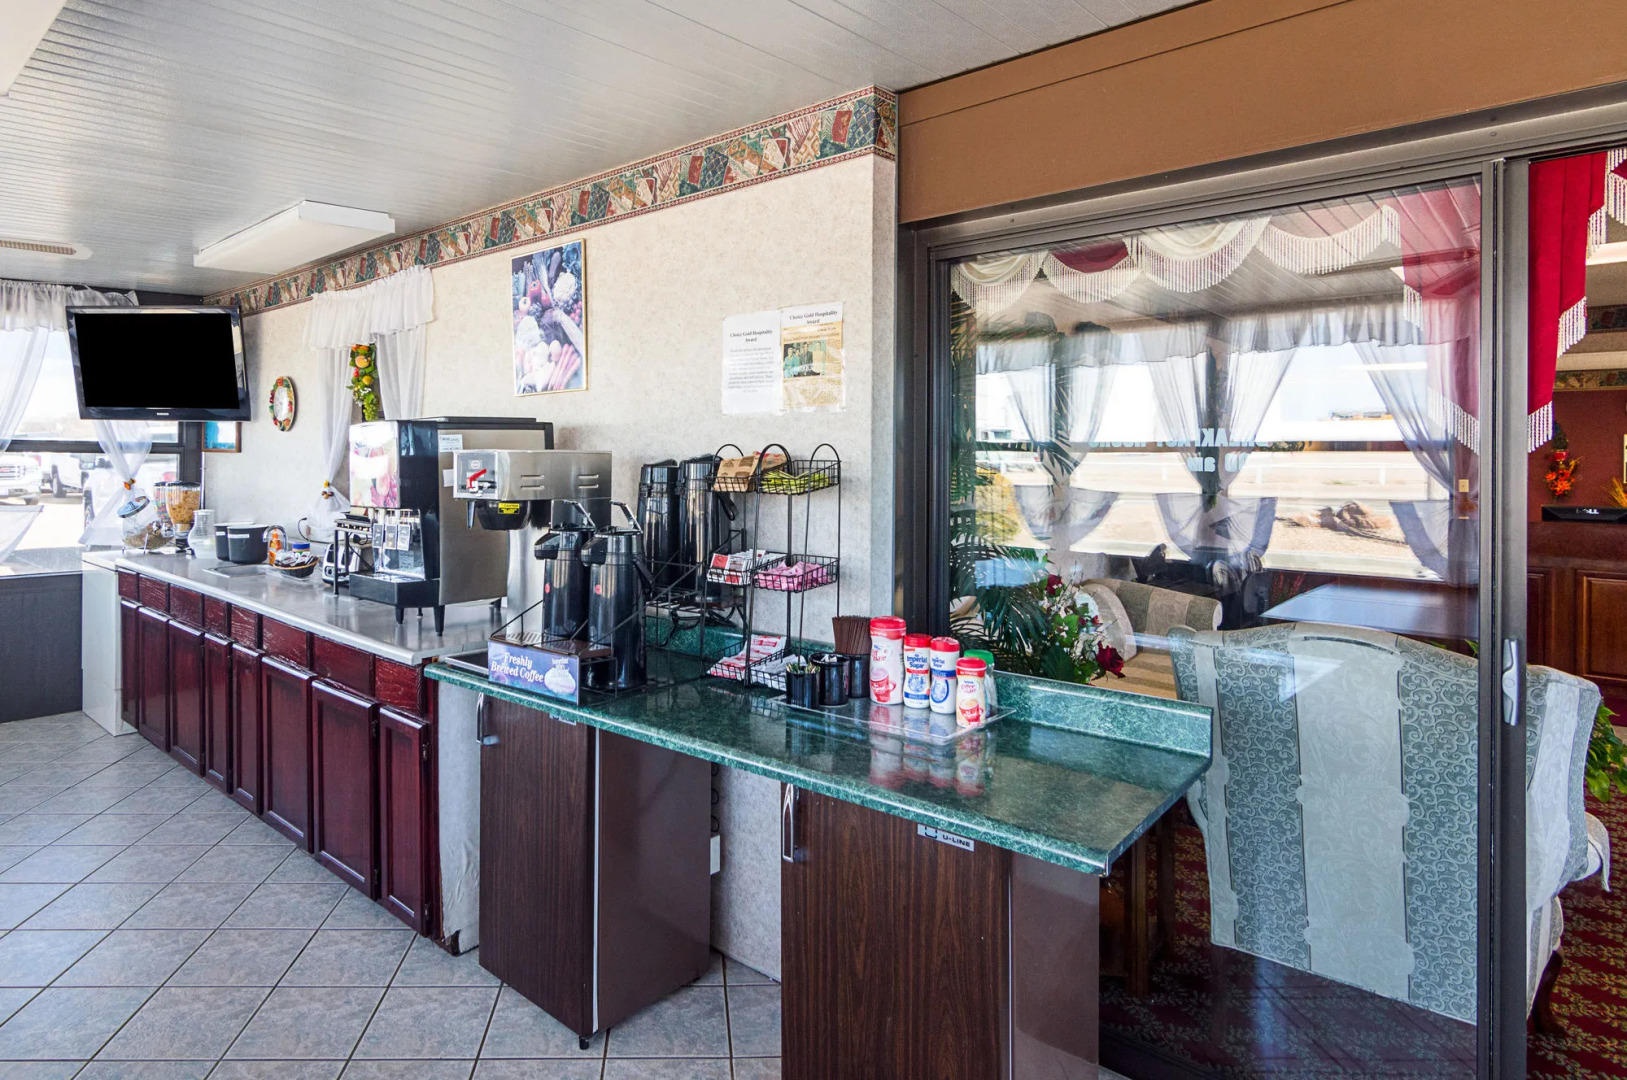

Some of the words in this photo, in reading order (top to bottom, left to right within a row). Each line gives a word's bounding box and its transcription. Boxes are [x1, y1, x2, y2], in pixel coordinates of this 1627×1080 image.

[504, 652, 532, 669] Freshly
[906, 656, 928, 664] Imperial
[490, 660, 519, 676] Brewed
[520, 668, 543, 682] Coffee
[942, 834, 970, 848] U-LINE
